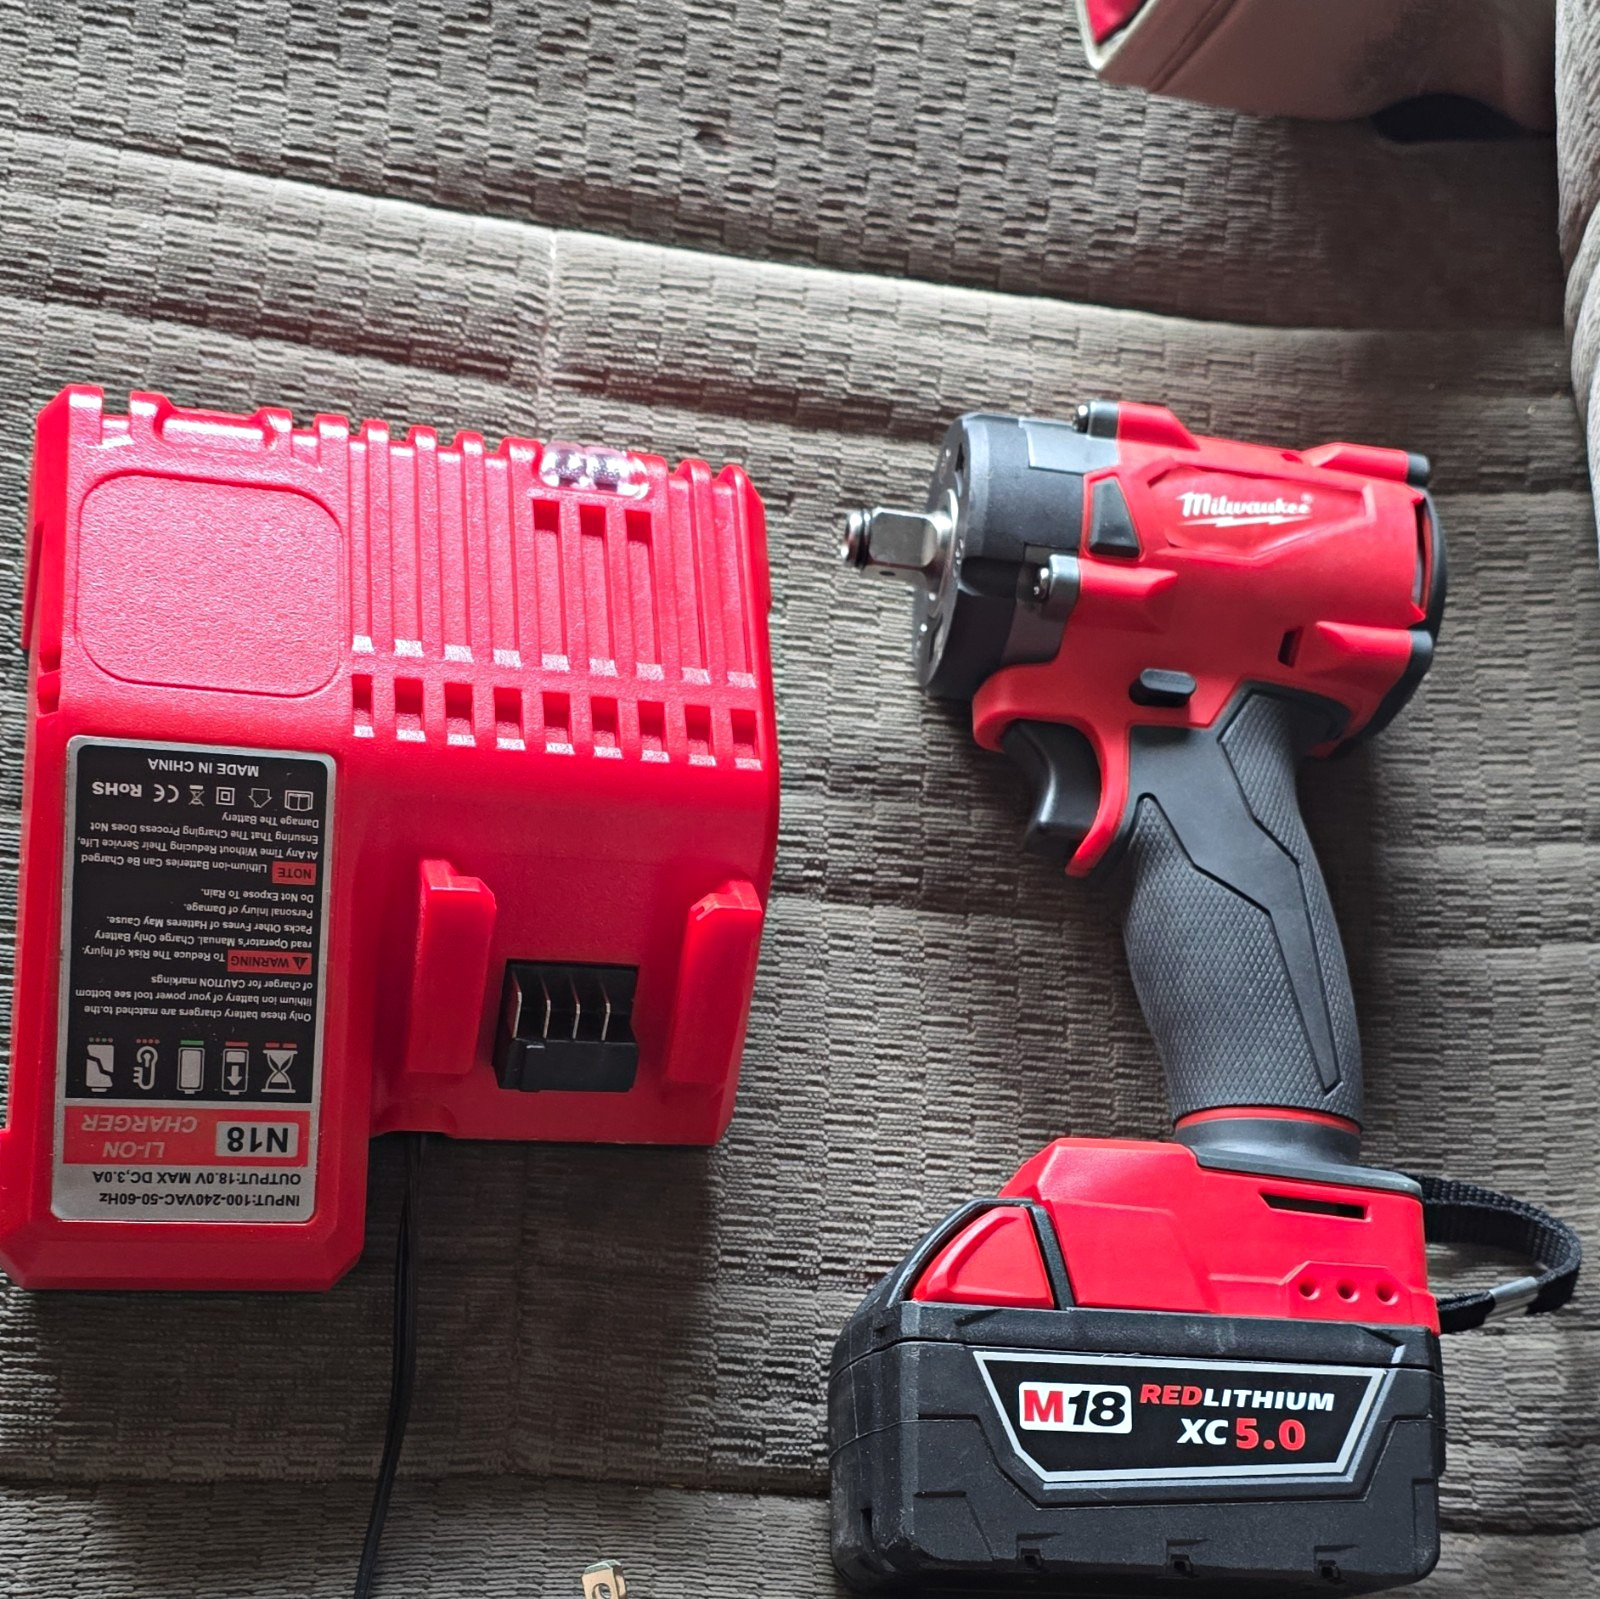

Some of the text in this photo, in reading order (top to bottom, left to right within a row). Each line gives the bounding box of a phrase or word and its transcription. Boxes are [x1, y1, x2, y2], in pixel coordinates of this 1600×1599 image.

[1176, 491, 1310, 517] Milwaukee
[148, 759, 259, 777] MADE IN CHINA
[92, 782, 142, 797] RoHS
[222, 812, 319, 828] Damage The Battery
[90, 822, 318, 844] Ensuring That The Charging Process Does Not
[102, 839, 139, 850] Service
[142, 842, 167, 851] Their
[170, 841, 217, 854] Reducing
[220, 846, 258, 856] Without
[260, 848, 283, 858] Time
[286, 848, 305, 859] Any
[307, 851, 318, 859] At
[81, 853, 311, 879] NOTE Lithium-ion Batteries Can Be Charged
[228, 890, 240, 899] To
[243, 890, 278, 901] Expose
[281, 893, 298, 902] Not
[301, 894, 314, 903] Do
[228, 906, 238, 914] of
[271, 908, 313, 918] Personal
[143, 916, 164, 927] May
[210, 921, 220, 929] of
[254, 924, 281, 933] Other
[284, 925, 312, 934] Packs
[95, 930, 131, 942] Battery
[134, 931, 156, 943] Only
[159, 933, 194, 944] Charge
[238, 938, 288, 948] Operator's
[291, 941, 311, 949] read
[115, 949, 125, 957] of
[128, 949, 150, 959] Risk
[153, 951, 171, 959] The
[174, 952, 211, 961] Reduce
[214, 953, 224, 961] To
[231, 956, 288, 968] WARNING
[151, 974, 312, 990] of charger for CAUTION markings
[76, 989, 111, 998] bottom
[134, 992, 153, 1000] tool
[188, 992, 211, 1001] your
[213, 994, 223, 1002] of
[226, 993, 259, 1004] battery
[262, 996, 277, 1005] ion
[280, 997, 312, 1006] lithium
[116, 1006, 158, 1015] matched
[179, 1007, 222, 1018] chargers
[225, 1009, 258, 1019] battery
[261, 1012, 286, 1020] these
[289, 1011, 311, 1022] Only
[81, 1114, 198, 1132] CHARGER
[227, 1127, 289, 1153] N18
[103, 1142, 165, 1158] LI-ON
[157, 1172, 191, 1184] MAX
[195, 1172, 301, 1185] OUTPUT:18.0V
[1139, 1384, 1335, 1412] REDLITHIUM
[1023, 1389, 1126, 1427] M18
[1176, 1417, 1306, 1451] XC 5.0
